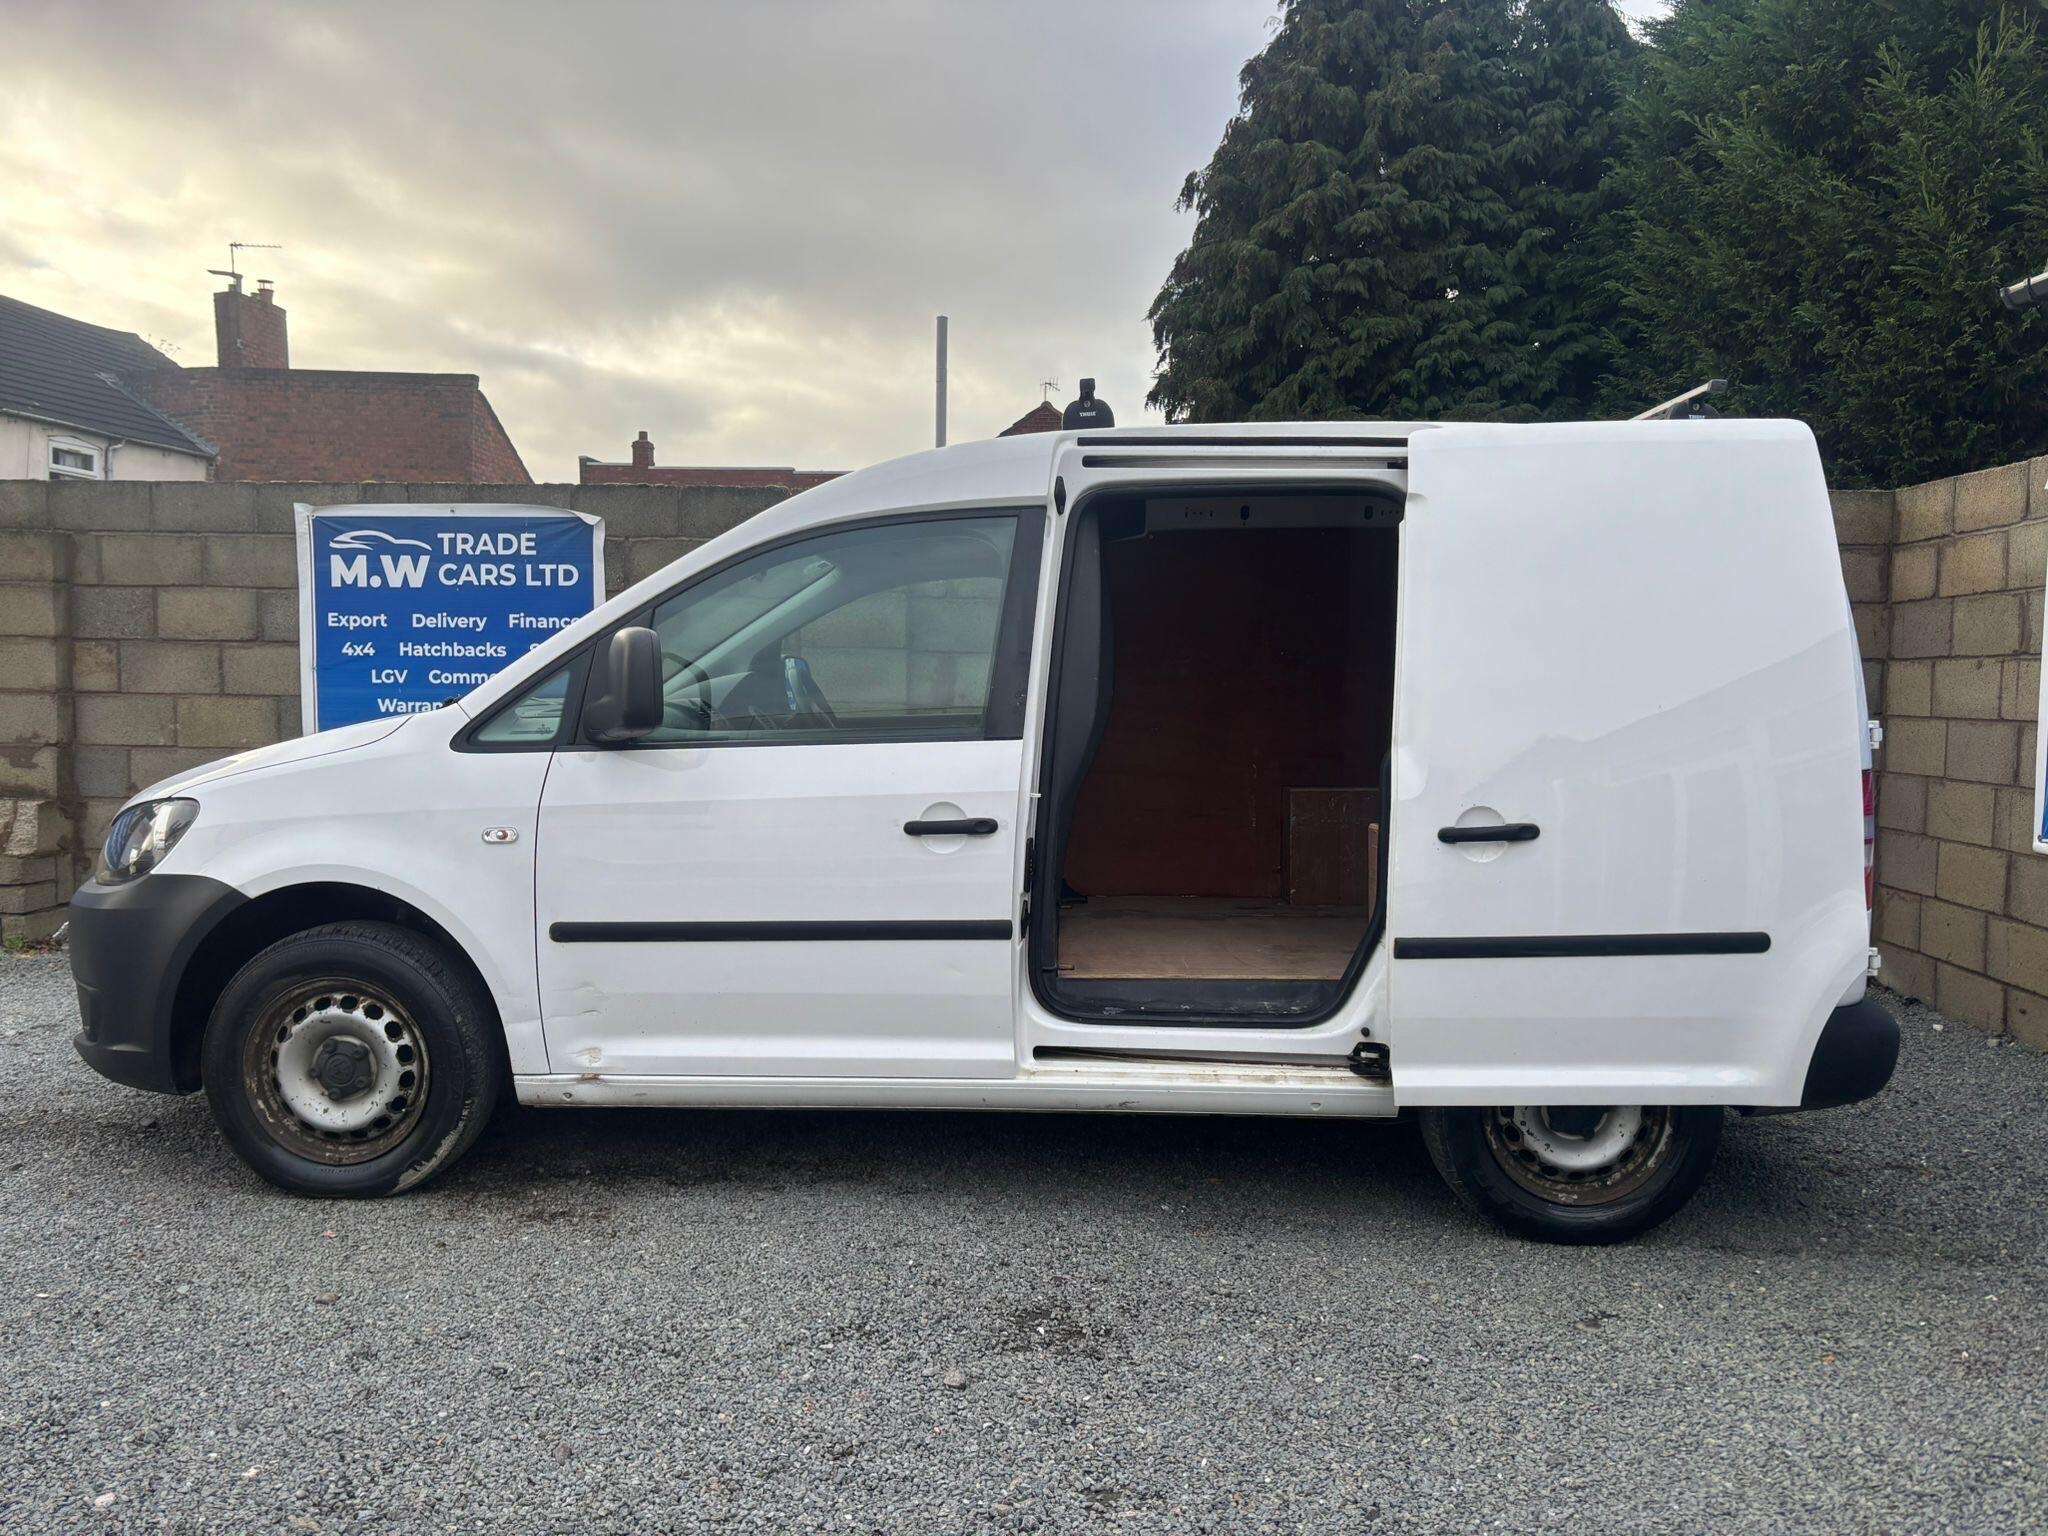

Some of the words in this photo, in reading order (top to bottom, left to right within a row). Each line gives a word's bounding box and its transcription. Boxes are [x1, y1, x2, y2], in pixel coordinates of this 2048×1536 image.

[437, 532, 537, 555] TRADE
[330, 554, 431, 588] M.W
[438, 563, 517, 587] CARS
[526, 563, 579, 586] LTD
[327, 612, 388, 630] Export
[412, 613, 487, 632] Delivery
[341, 641, 375, 656] 4x4
[399, 641, 507, 657] Hatchbacks
[371, 669, 408, 684] LGV
